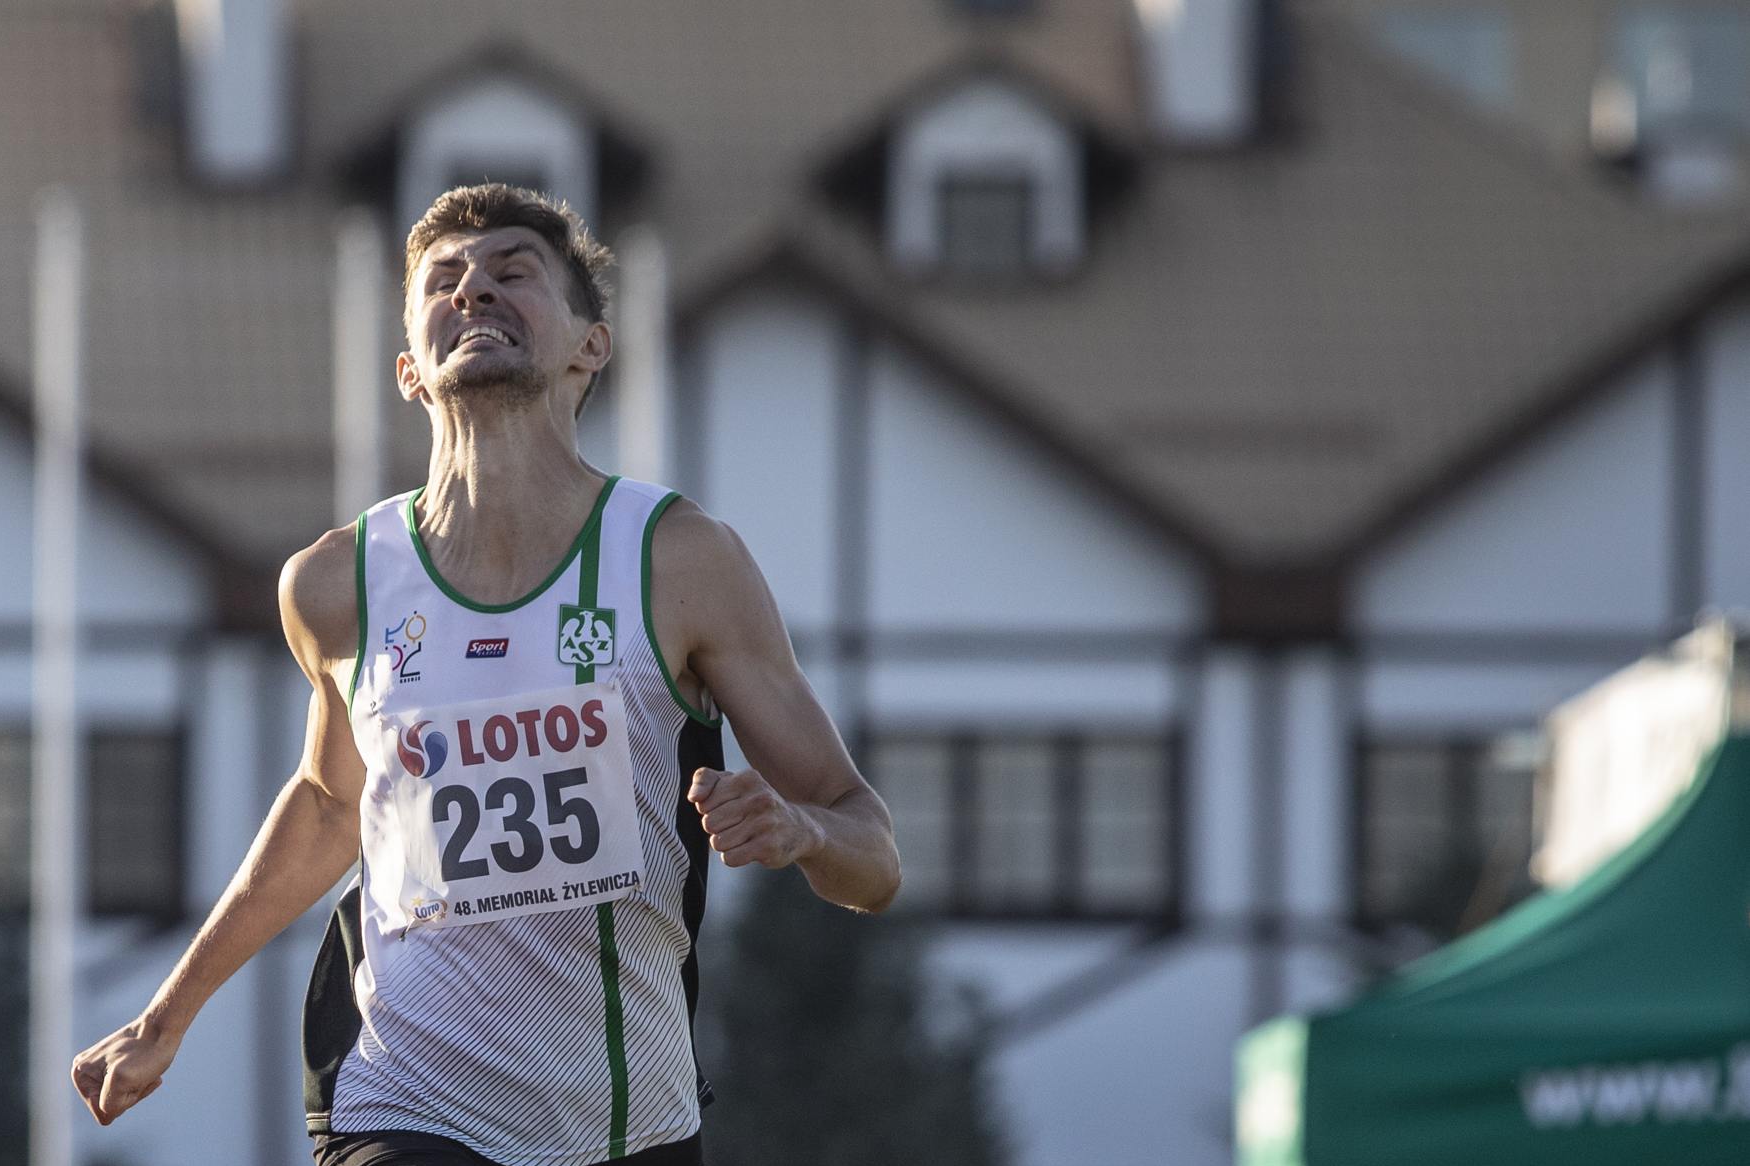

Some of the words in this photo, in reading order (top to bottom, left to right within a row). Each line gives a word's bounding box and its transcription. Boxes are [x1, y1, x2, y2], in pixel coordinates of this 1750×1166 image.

[470, 641, 505, 654] Sport
[456, 699, 608, 767] LOTOS
[432, 766, 600, 882] 235
[562, 870, 640, 900] ŻYLEWICZA
[1522, 1044, 1750, 1124] www.
